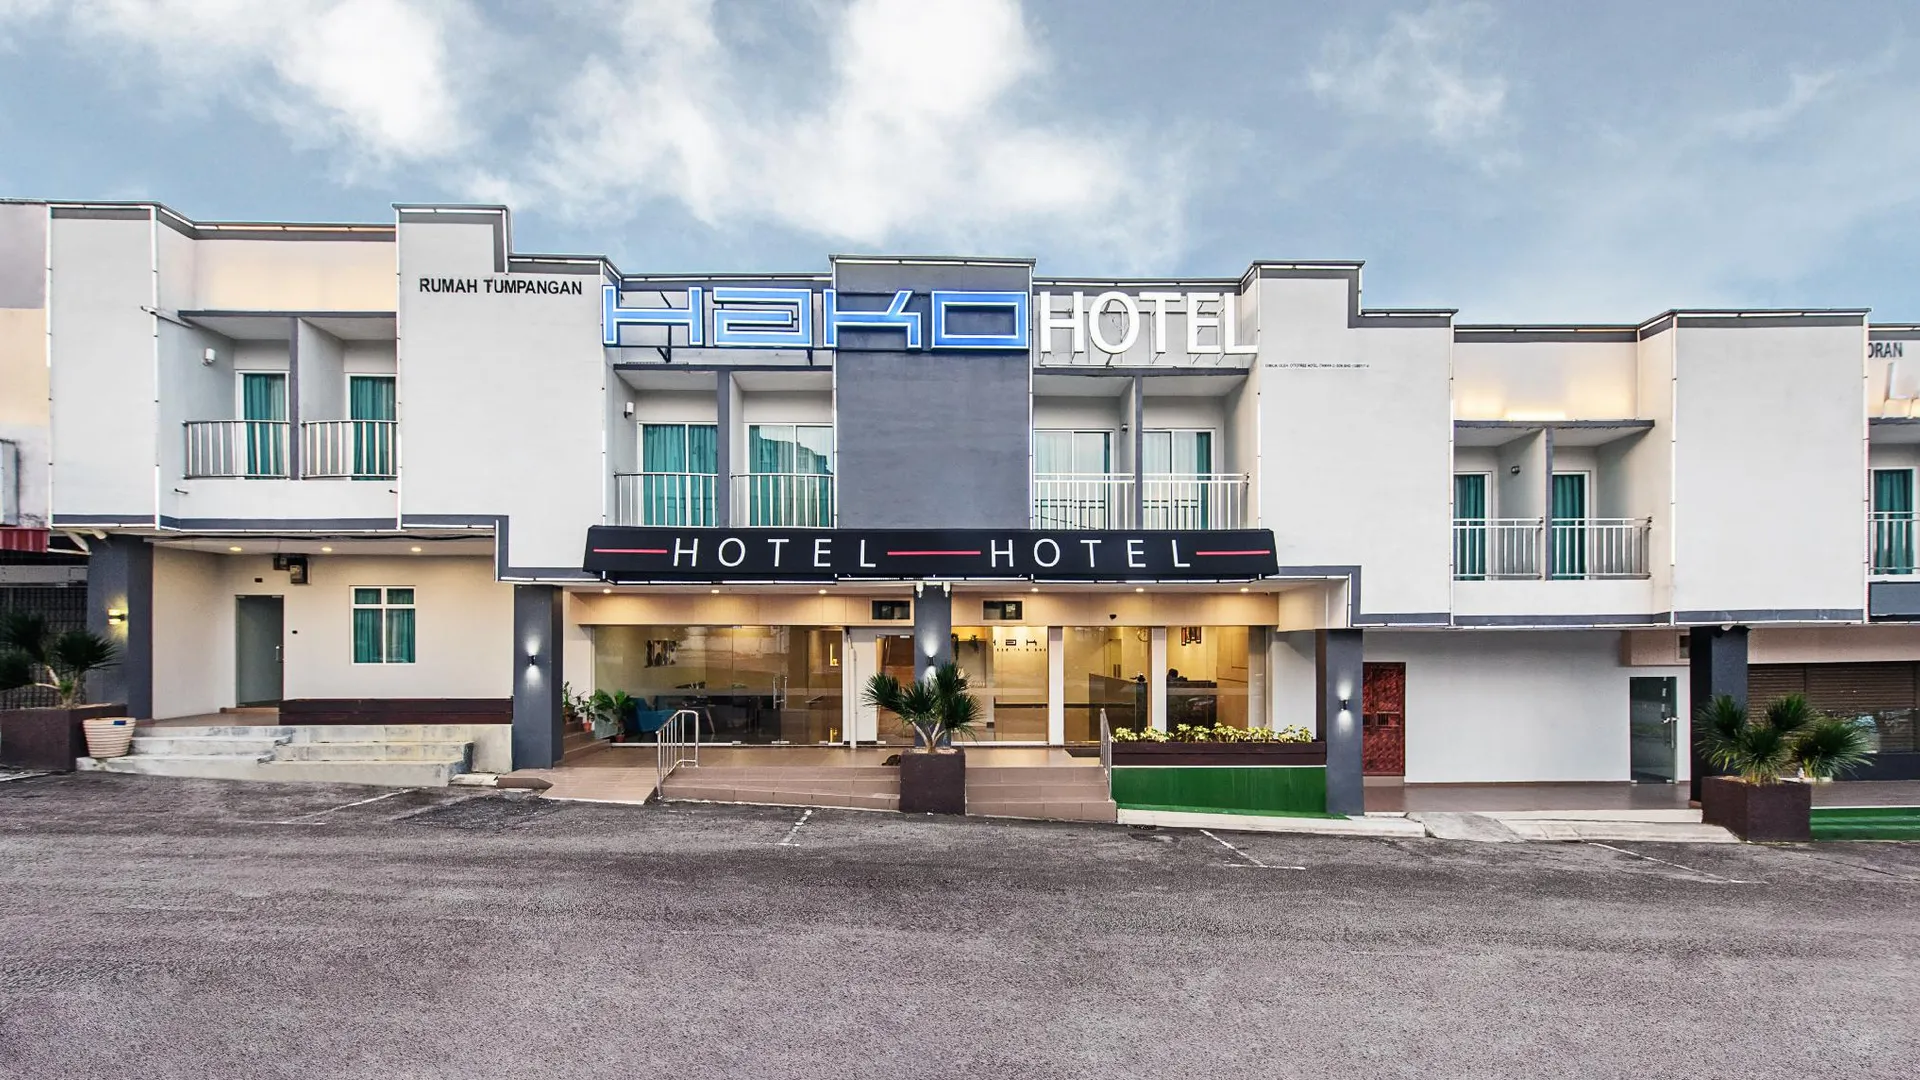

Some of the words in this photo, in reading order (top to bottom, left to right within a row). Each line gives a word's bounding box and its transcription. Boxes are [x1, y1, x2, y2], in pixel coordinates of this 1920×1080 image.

[420, 278, 477, 293] RUMAH
[484, 279, 582, 294] TUMPANGAN
[1039, 291, 1258, 354] HOTEL
[673, 537, 877, 569] HOTEL
[990, 538, 1191, 570] HOTEL
